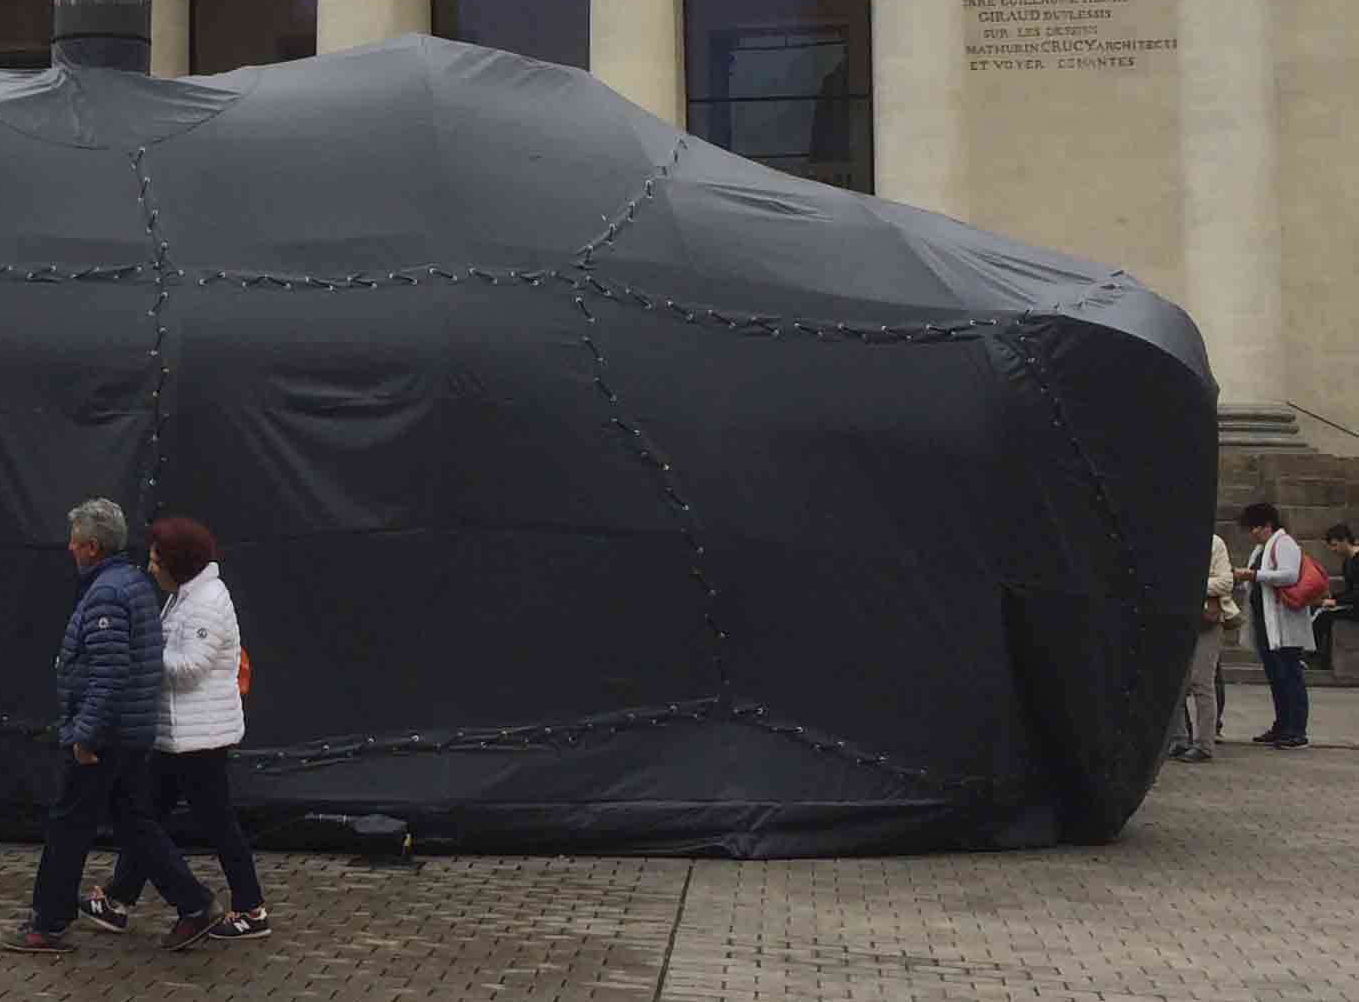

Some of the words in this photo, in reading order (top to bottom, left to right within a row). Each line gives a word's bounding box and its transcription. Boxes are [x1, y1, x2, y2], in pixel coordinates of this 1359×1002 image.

[1041, 39, 1098, 54] CRUCY
[969, 60, 987, 71] ET
[232, 918, 251, 933] N
